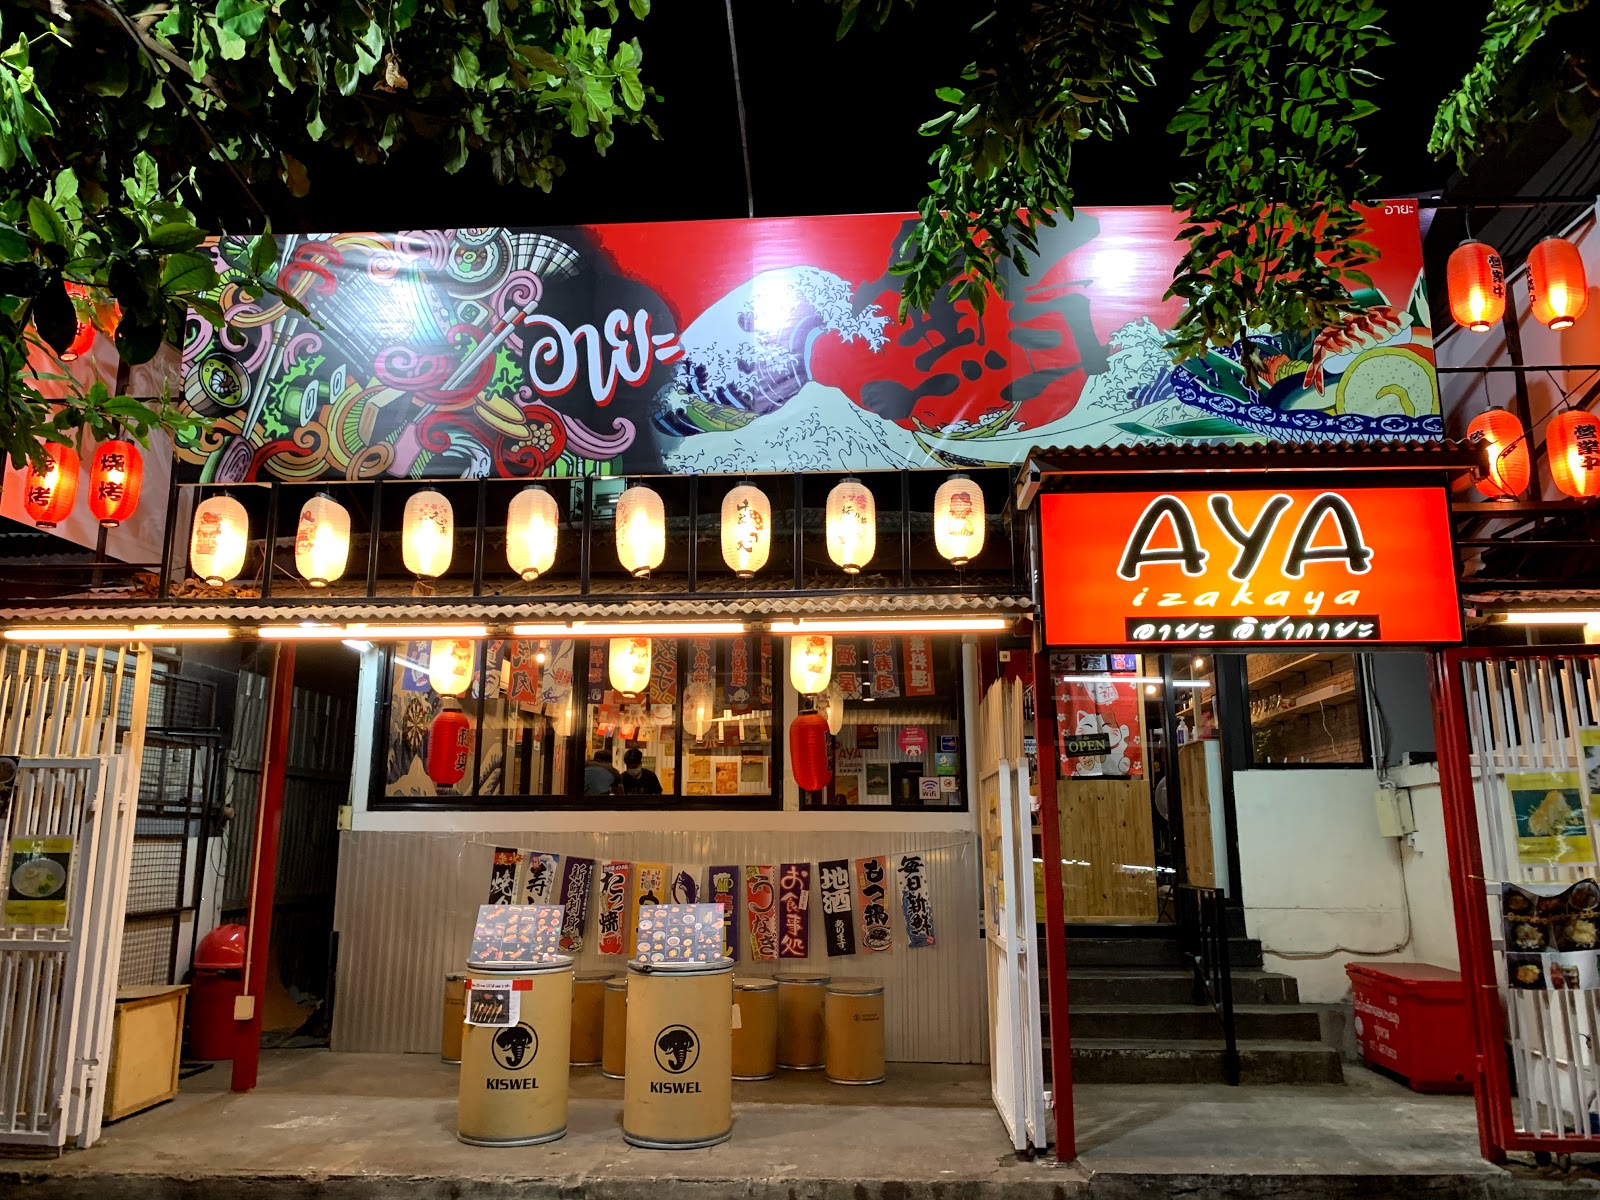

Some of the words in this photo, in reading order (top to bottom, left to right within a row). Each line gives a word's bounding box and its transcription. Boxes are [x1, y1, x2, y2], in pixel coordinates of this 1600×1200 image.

[1384, 204, 1414, 215] อายะ
[524, 309, 686, 407] อายะ
[1116, 492, 1374, 581] AYA
[1132, 582, 1361, 615] izakaya
[1132, 621, 1215, 641] อายะ
[1232, 615, 1375, 641] อิซากายะ
[1068, 739, 1106, 753] OPEN
[921, 789, 937, 797] Wifi
[820, 866, 852, 915] 地酒
[749, 875, 775, 956] うなぎ
[781, 866, 809, 956] お食事処
[486, 1077, 539, 1090] KISWEL
[649, 1081, 702, 1094] KISWEL
